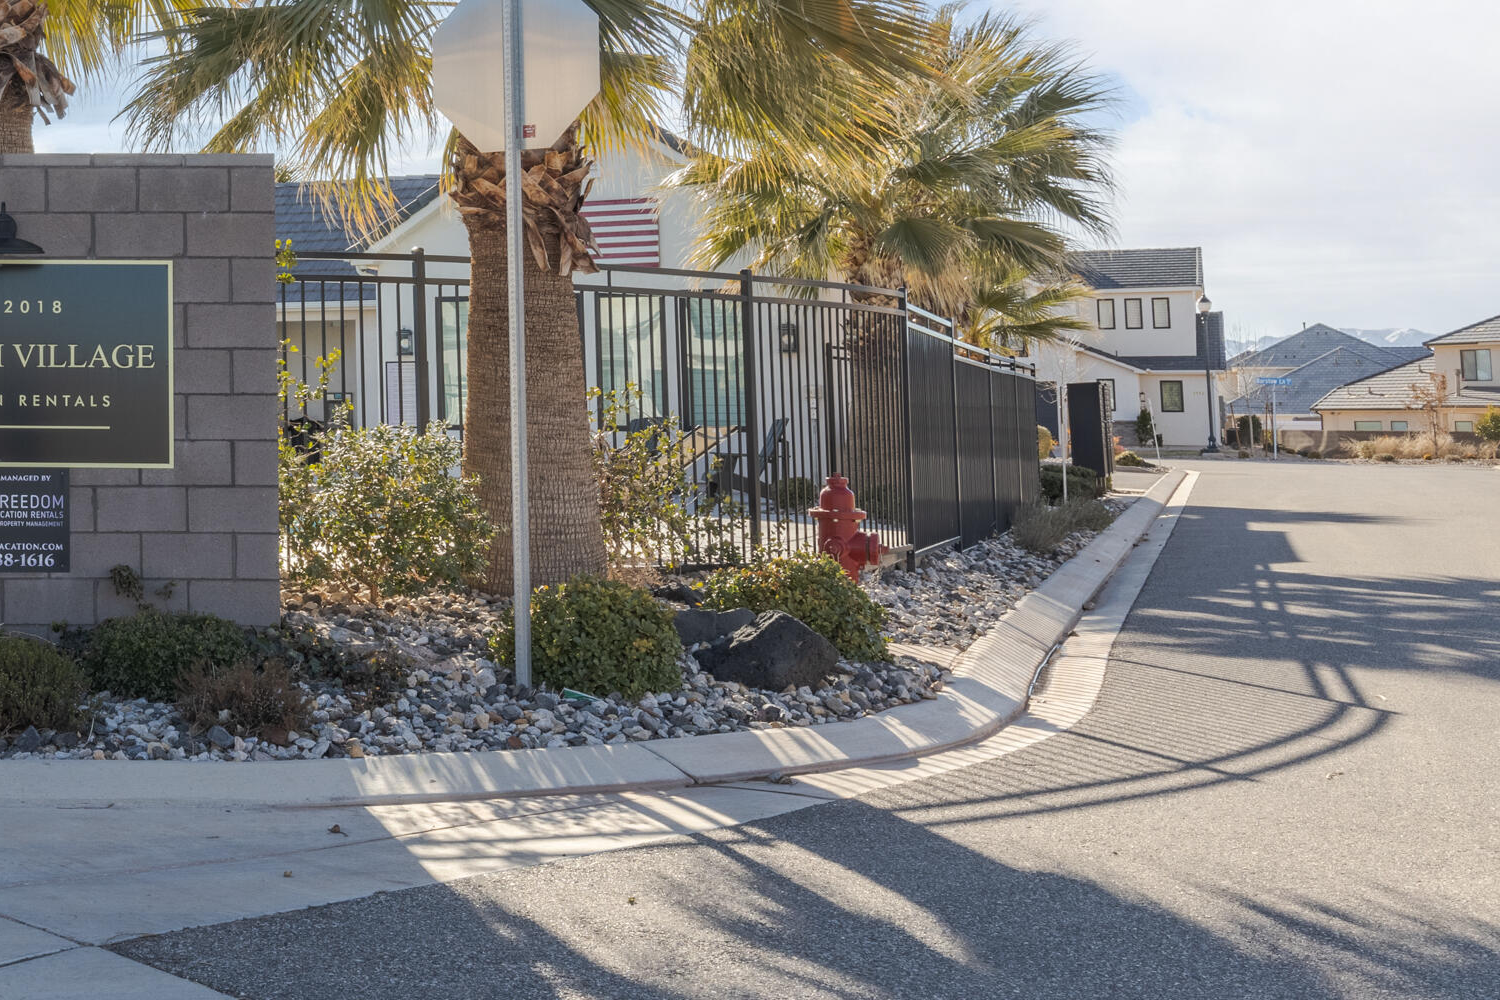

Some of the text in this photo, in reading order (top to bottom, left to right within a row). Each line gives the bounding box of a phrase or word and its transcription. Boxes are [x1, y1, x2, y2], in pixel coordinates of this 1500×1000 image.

[3, 300, 63, 314] 2018
[12, 343, 156, 369] VILLAGE
[18, 394, 112, 408] RENTALS
[30, 510, 64, 519] RENTALS
